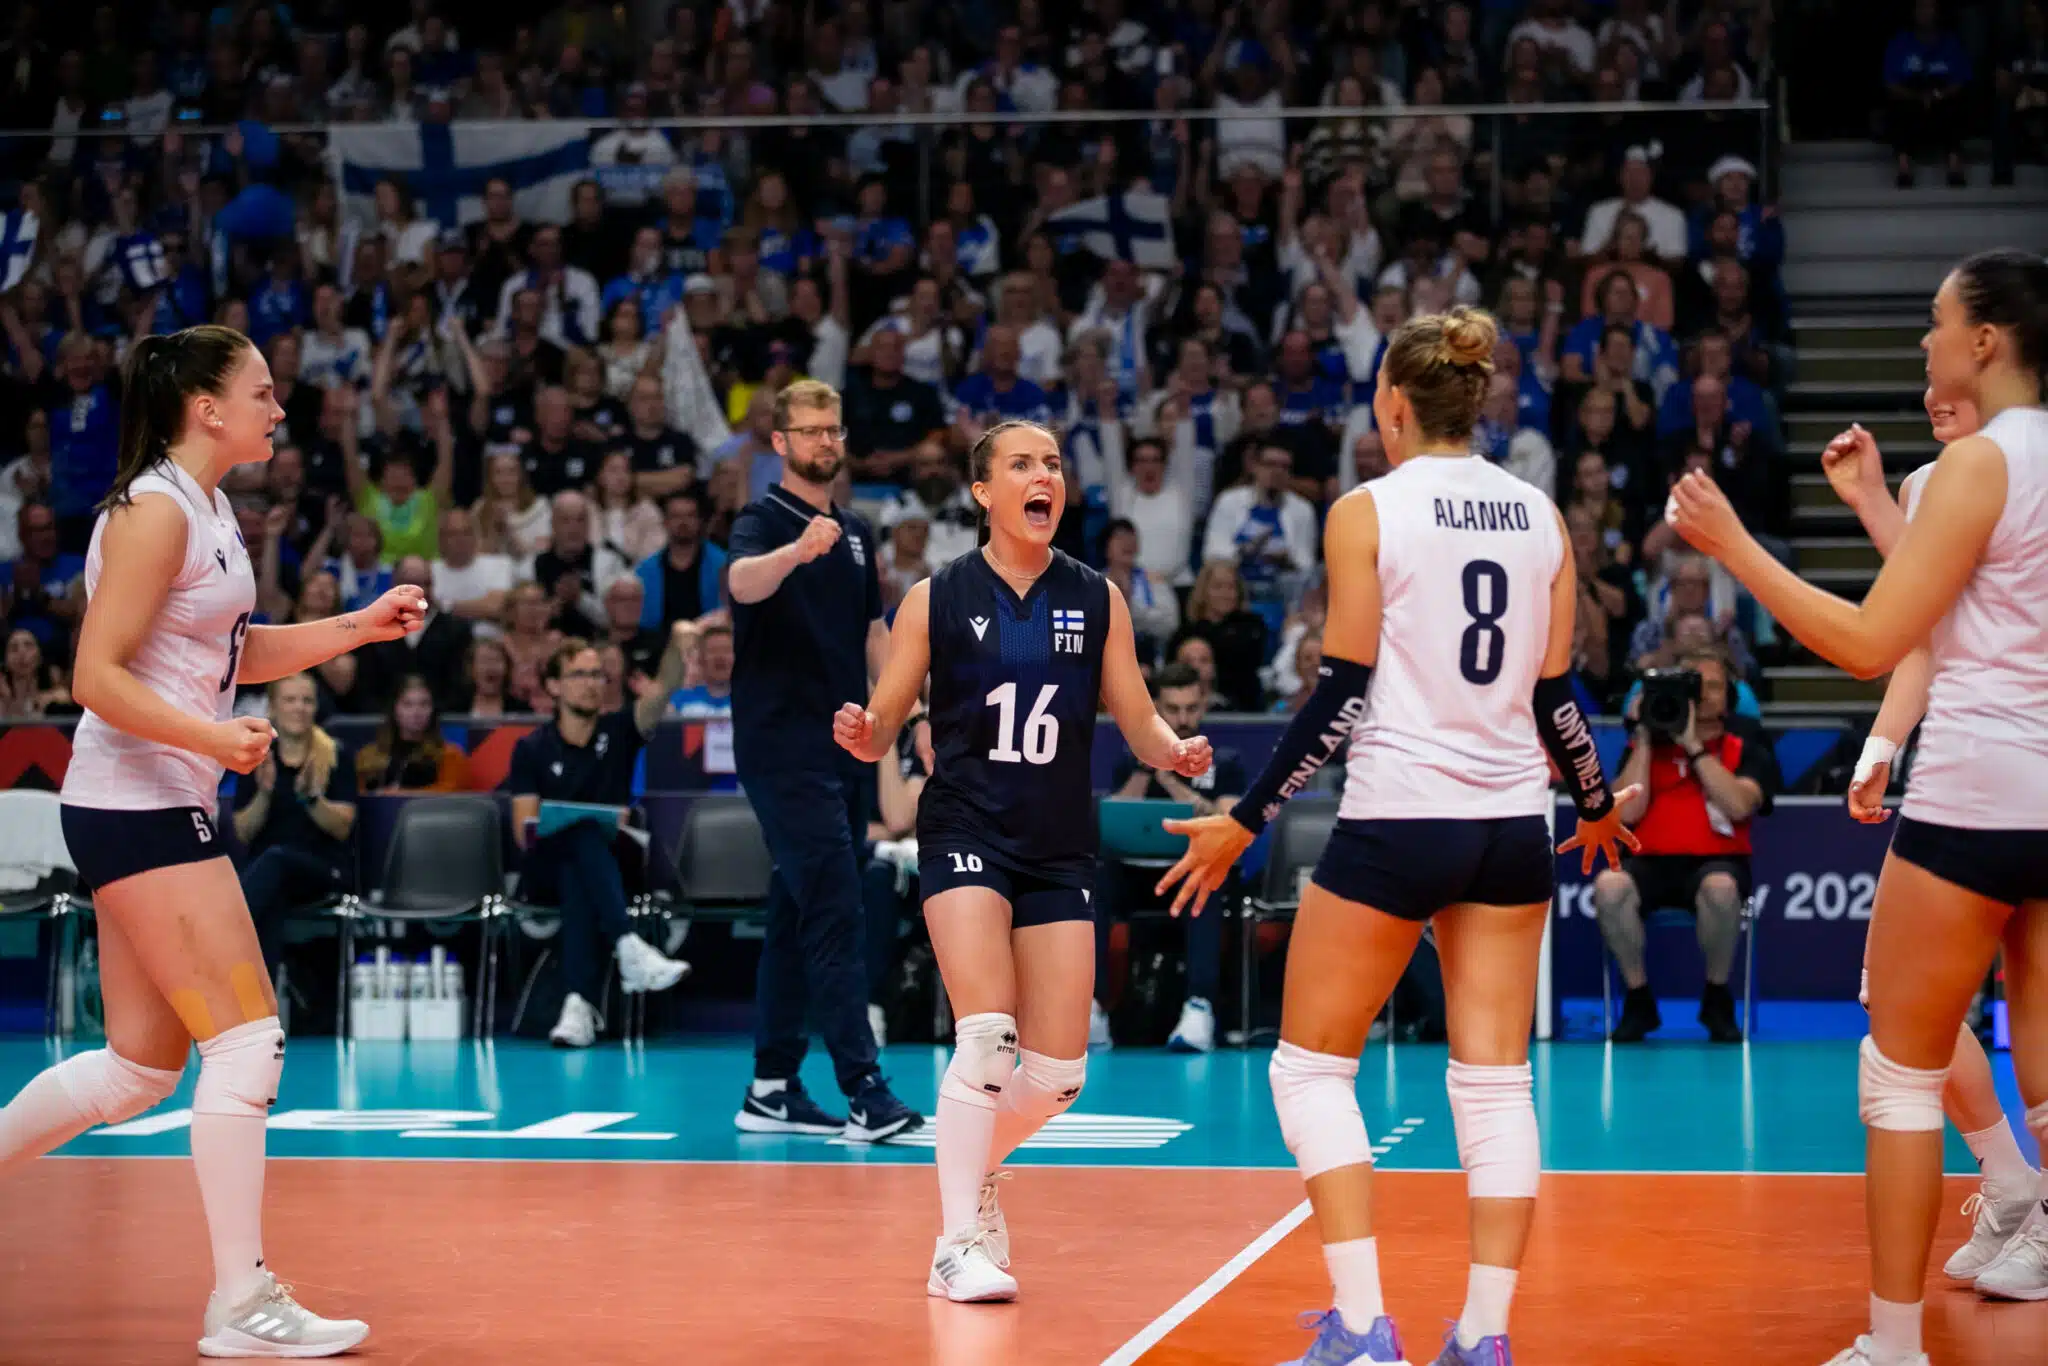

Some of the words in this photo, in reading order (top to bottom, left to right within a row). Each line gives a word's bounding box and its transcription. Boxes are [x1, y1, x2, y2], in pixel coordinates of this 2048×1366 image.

[1434, 498, 1530, 531] ALANKO
[1054, 632, 1084, 654] FIN
[1460, 559, 1508, 685] 8
[985, 682, 1060, 765] 16
[1552, 701, 1602, 791] FINLAND
[1277, 696, 1366, 800] FINLAND
[191, 811, 212, 844] 5
[947, 852, 983, 873] 16
[1784, 872, 1877, 920] 202
